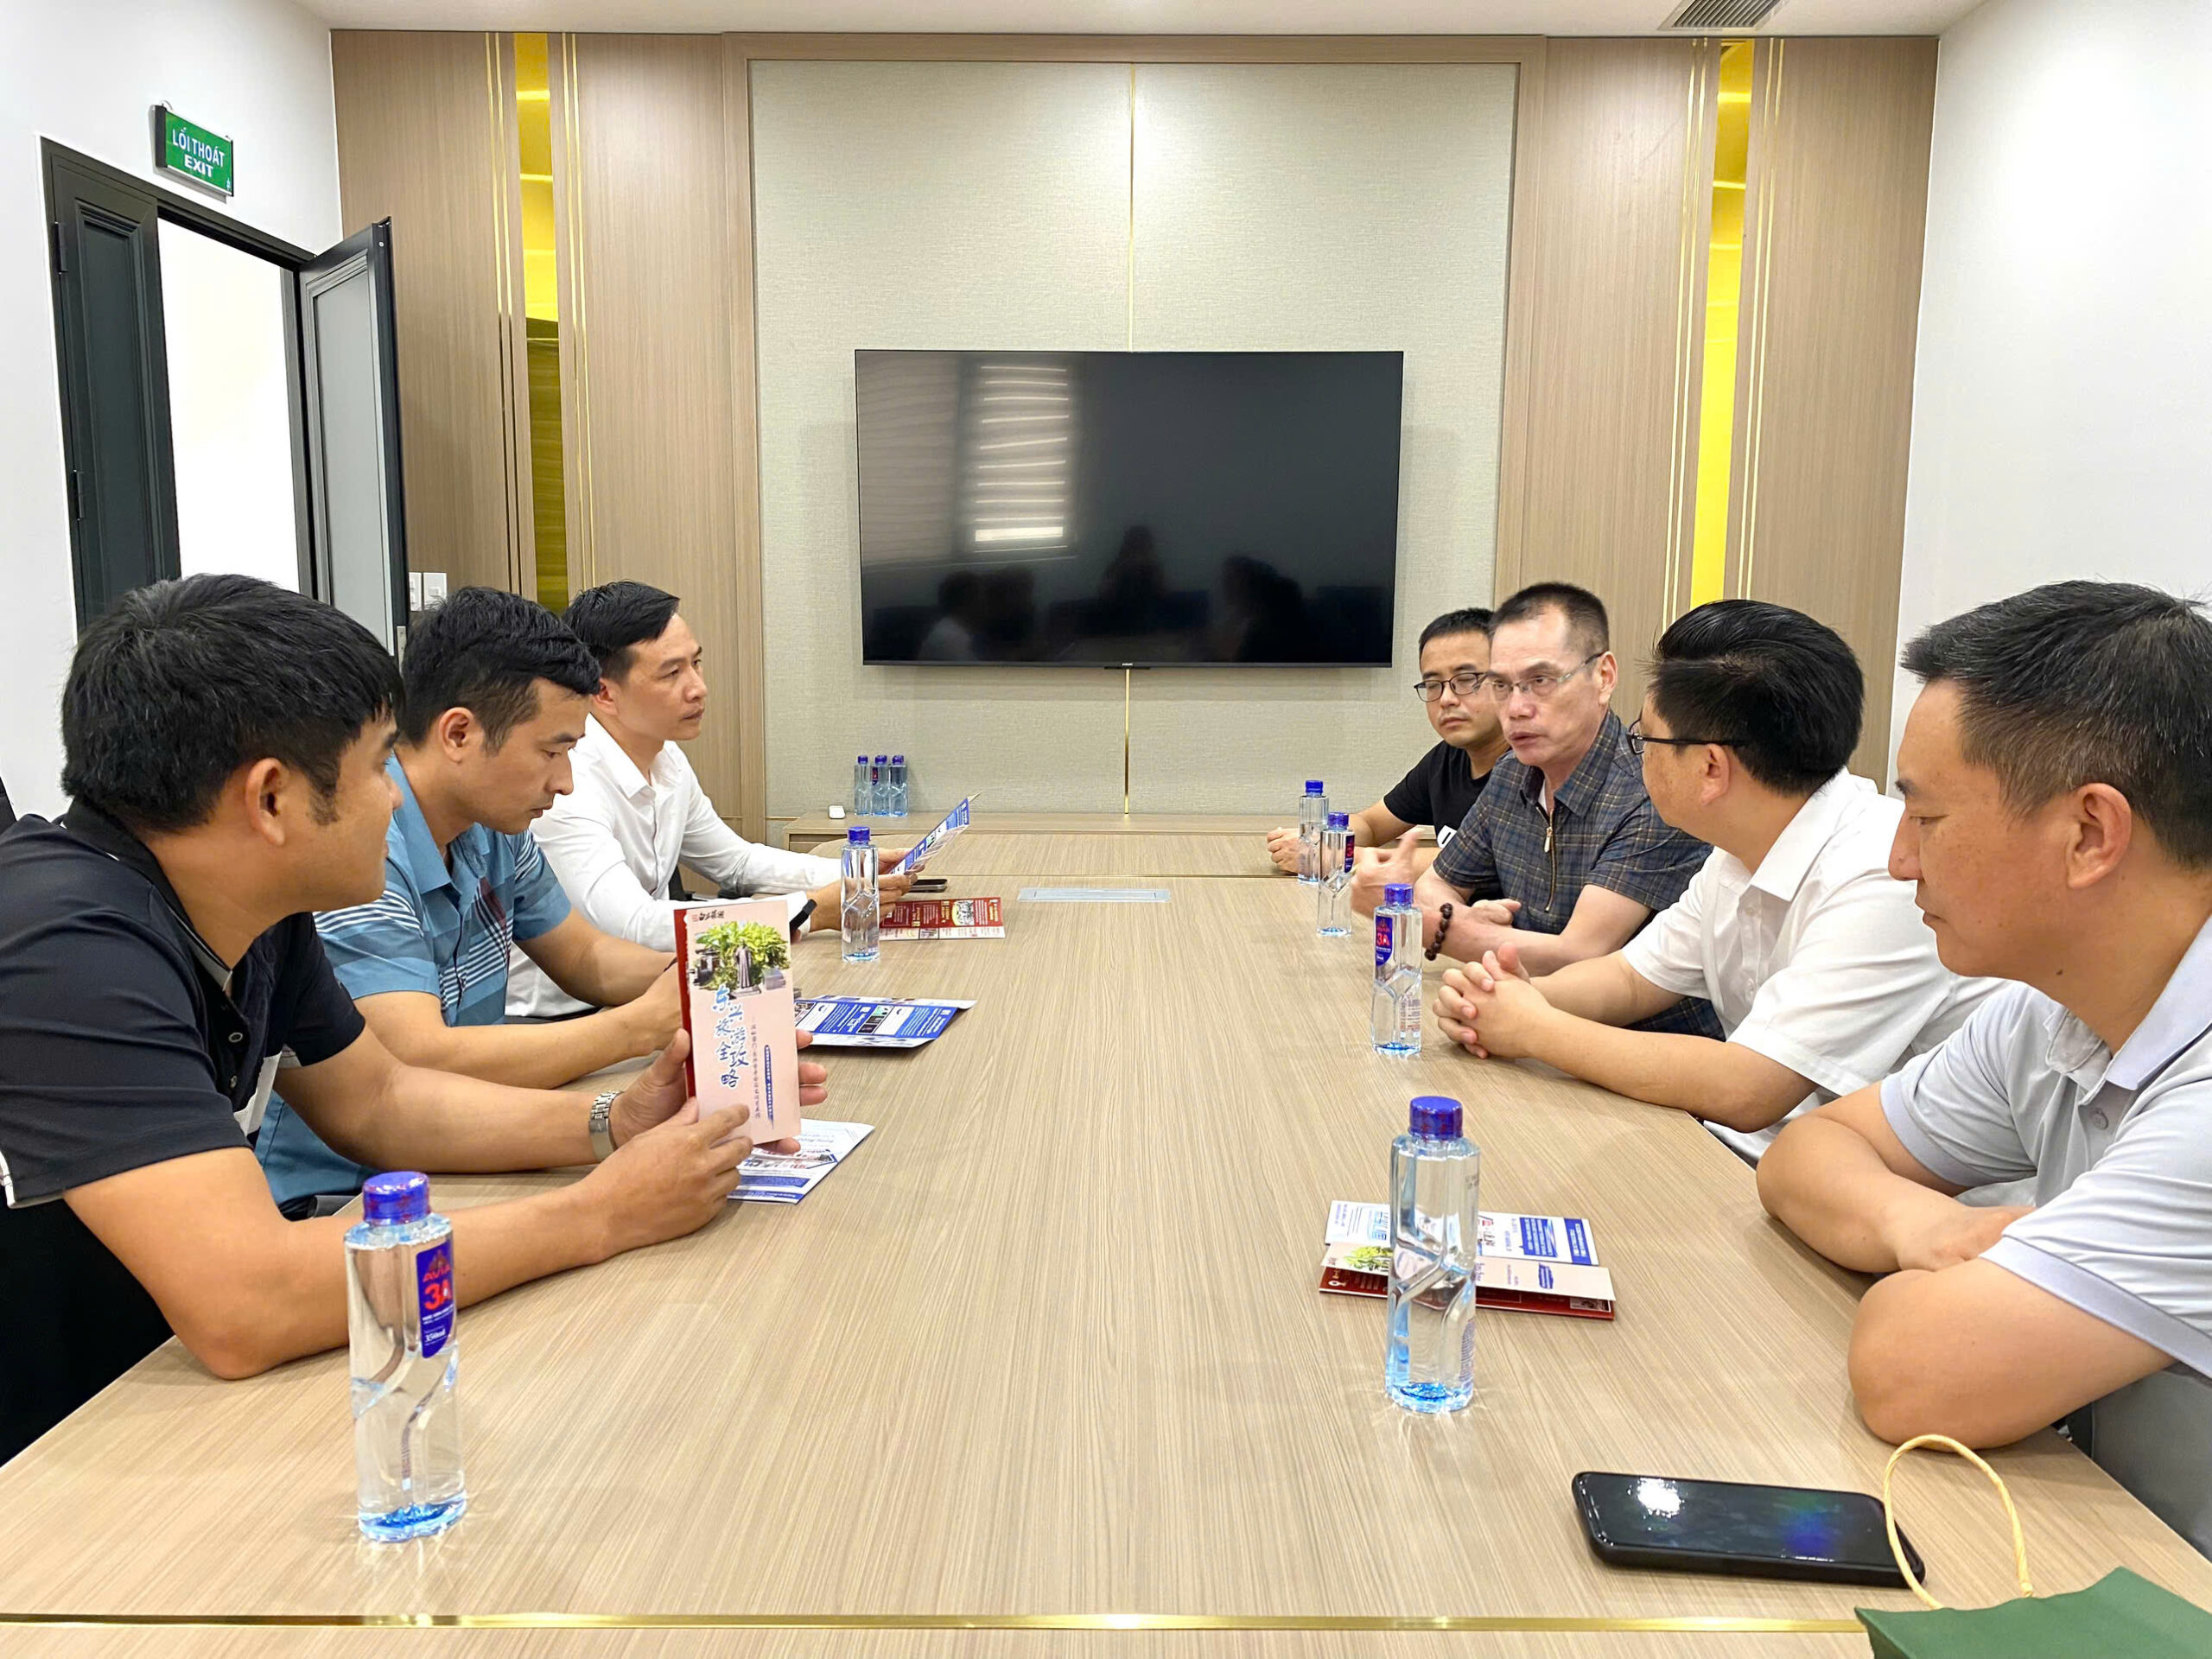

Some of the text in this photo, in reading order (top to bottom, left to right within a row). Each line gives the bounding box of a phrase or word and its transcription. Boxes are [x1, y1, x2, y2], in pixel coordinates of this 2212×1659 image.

[172, 127, 225, 168] LỐI THOÁT
[184, 154, 213, 178] EXIT
[423, 1279, 453, 1311] 3A
